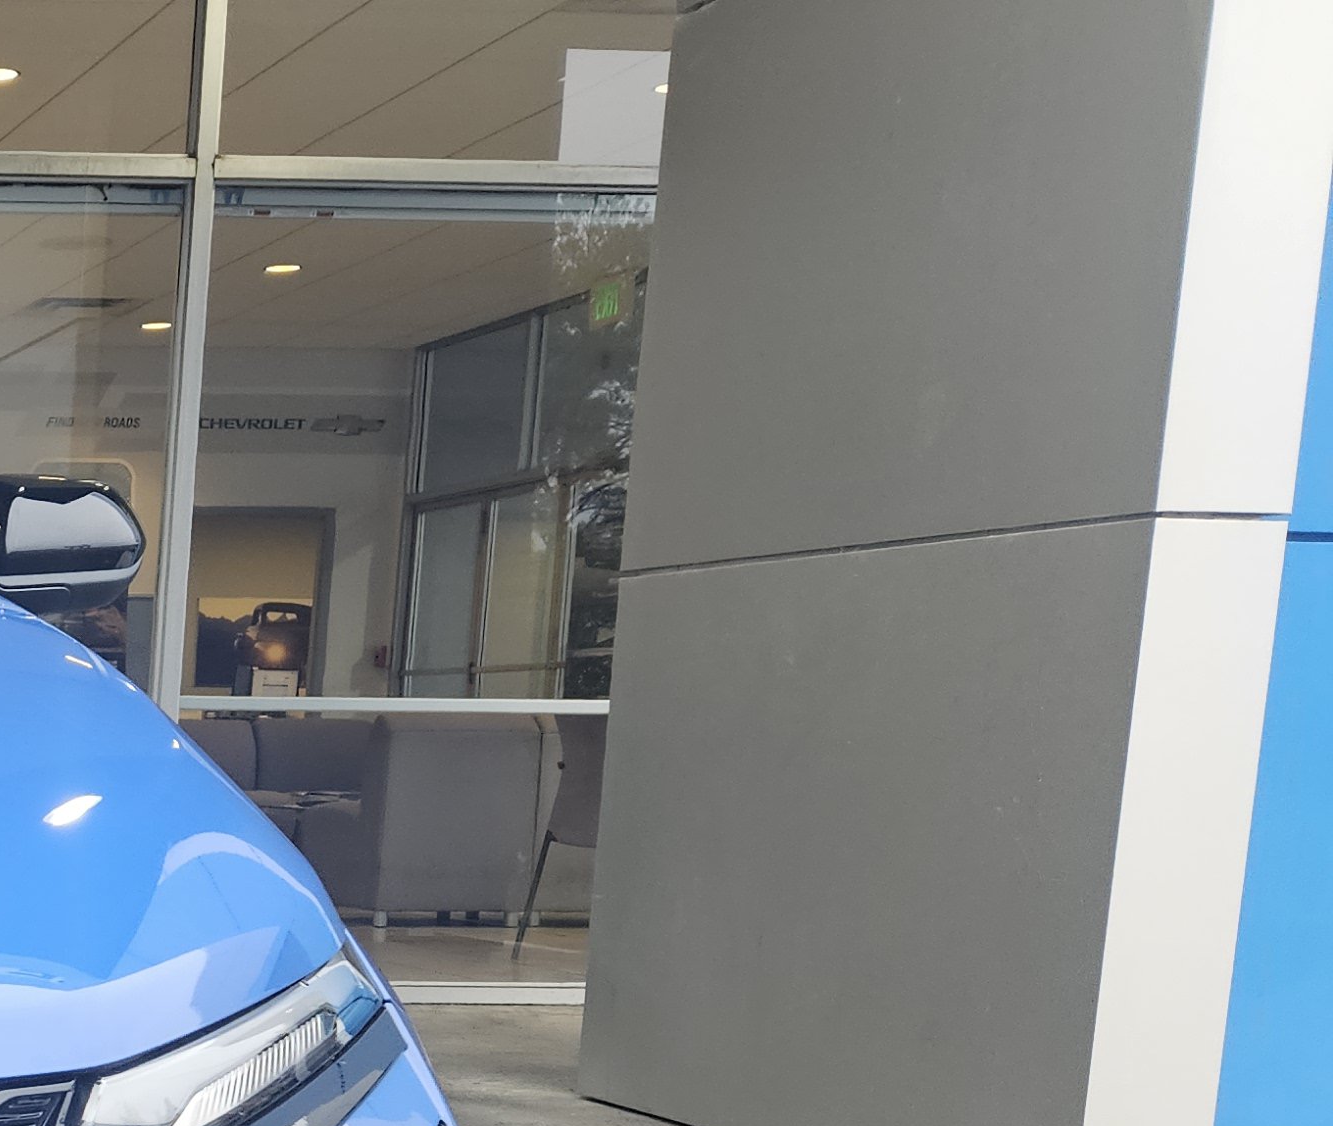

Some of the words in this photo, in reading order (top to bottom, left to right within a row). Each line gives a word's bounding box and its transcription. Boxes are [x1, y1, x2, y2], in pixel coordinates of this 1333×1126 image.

[46, 416, 75, 428] FIND
[103, 416, 141, 429] ROADS
[199, 417, 306, 430] CHEVROLET
